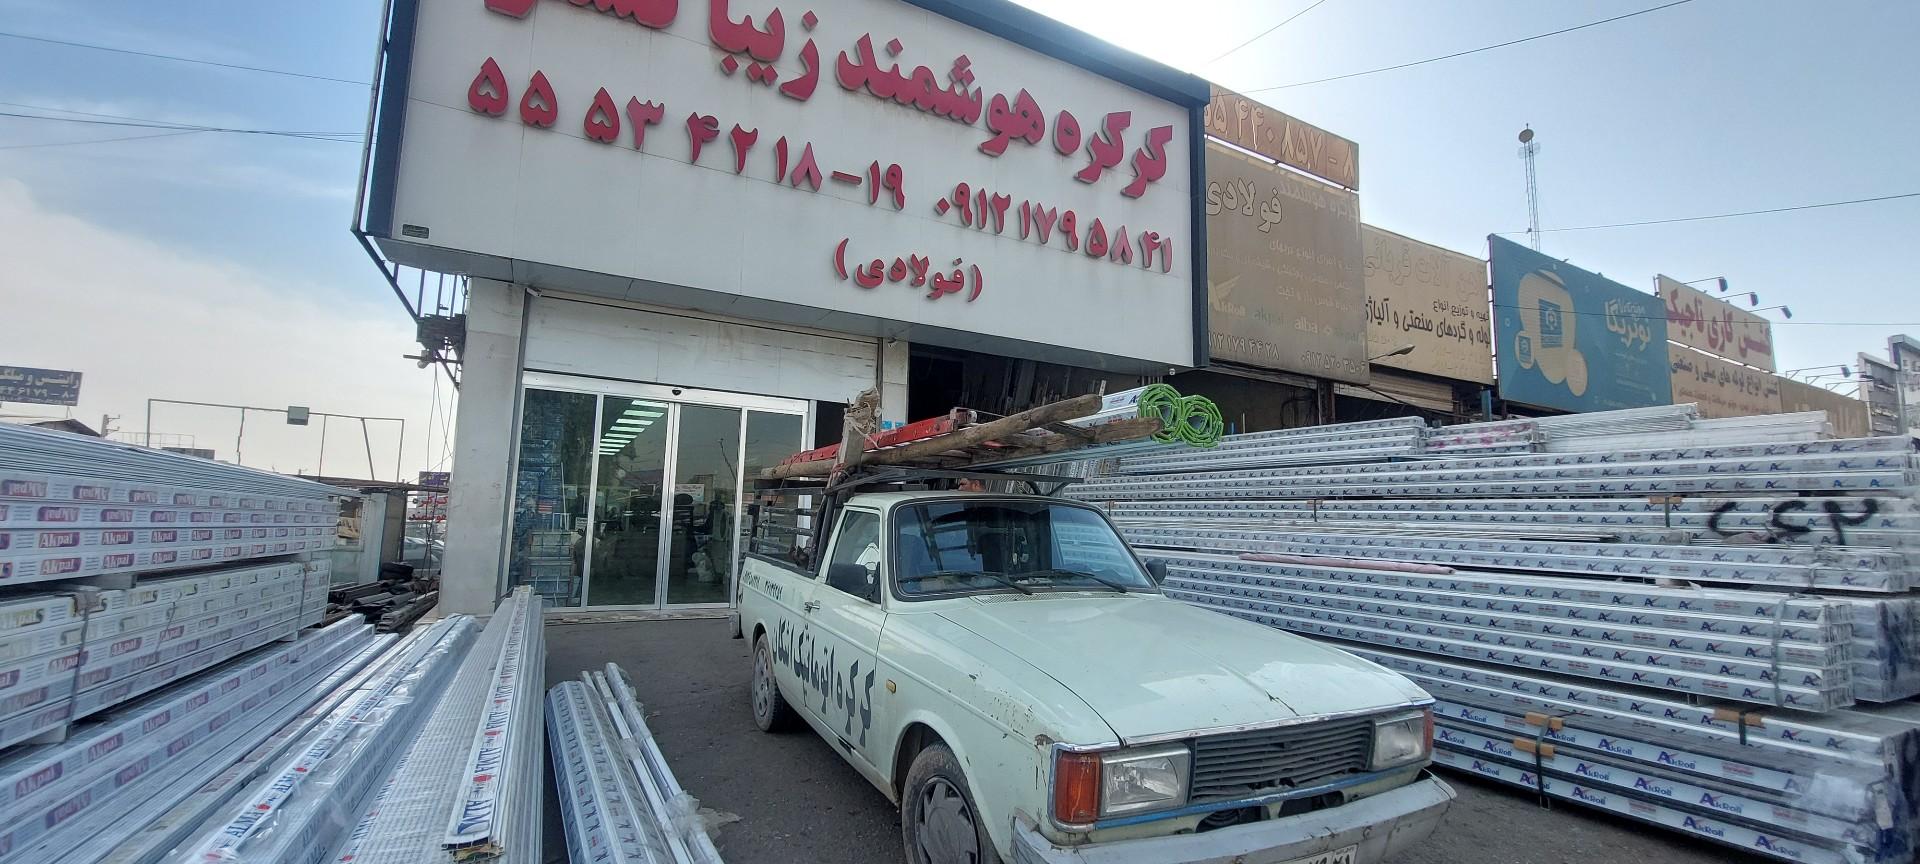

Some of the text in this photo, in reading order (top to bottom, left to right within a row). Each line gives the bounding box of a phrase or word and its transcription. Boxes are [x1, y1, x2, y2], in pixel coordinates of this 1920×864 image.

[709, 0, 1173, 198] کرکره هوشمند زیبا
[1207, 178, 1283, 233] فولادی
[834, 238, 983, 303] (فولادی)
[1394, 311, 1399, 328] و
[1433, 298, 1449, 312] انواع
[1403, 310, 1433, 331] صنعتی
[39, 533, 74, 548] Akpal
[102, 531, 129, 545] Akpal
[152, 530, 173, 543] Akpal
[41, 559, 74, 575] Akpal
[103, 555, 130, 569] Akpal
[153, 552, 173, 564] Akpal
[112, 638, 137, 657] Akpal
[794, 623, 835, 715] اتوماتیک
[837, 659, 875, 748] کرکره
[486, 712, 508, 730] ALMA
[16, 767, 55, 799] Akpal
[88, 735, 118, 763] Akpal
[144, 711, 166, 735] Akpal
[474, 748, 502, 774] ALMA
[1598, 738, 1633, 756] AkRoll
[1658, 750, 1696, 770] AkRoll
[1484, 740, 1513, 757] AkRoll
[1576, 763, 1611, 781] AkRoll
[1634, 777, 1673, 797] AkRoll
[1700, 793, 1743, 815] AkRoll
[1472, 760, 1500, 776] AkRoll
[1572, 786, 1607, 806] AkRoll
[1683, 816, 1725, 838] AkRoll
[224, 811, 265, 838] ALMA
